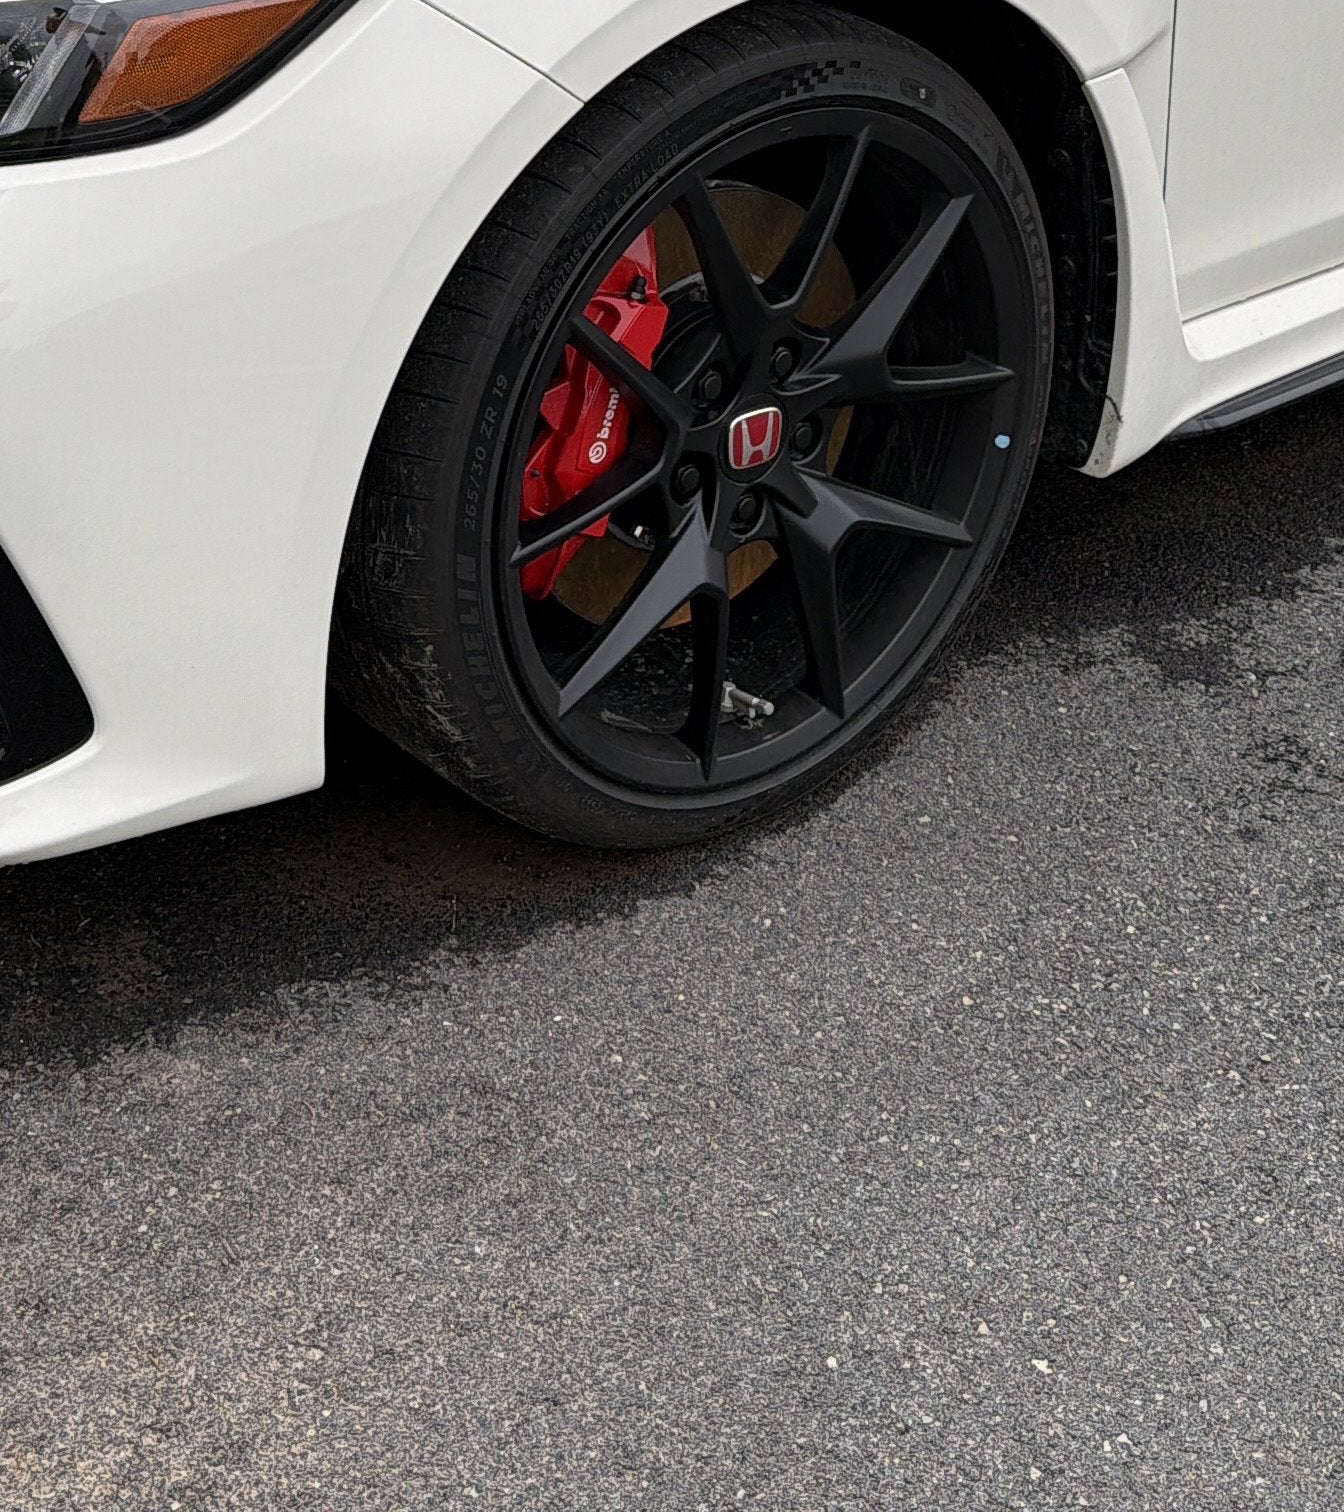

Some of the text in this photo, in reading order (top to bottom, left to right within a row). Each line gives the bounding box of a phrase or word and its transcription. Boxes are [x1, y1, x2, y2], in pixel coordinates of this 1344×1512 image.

[614, 169, 649, 210] EXTRA
[649, 143, 680, 178] LOAD
[463, 374, 509, 532] 265/30 ZR 19
[456, 552, 524, 744] MICHELIN
